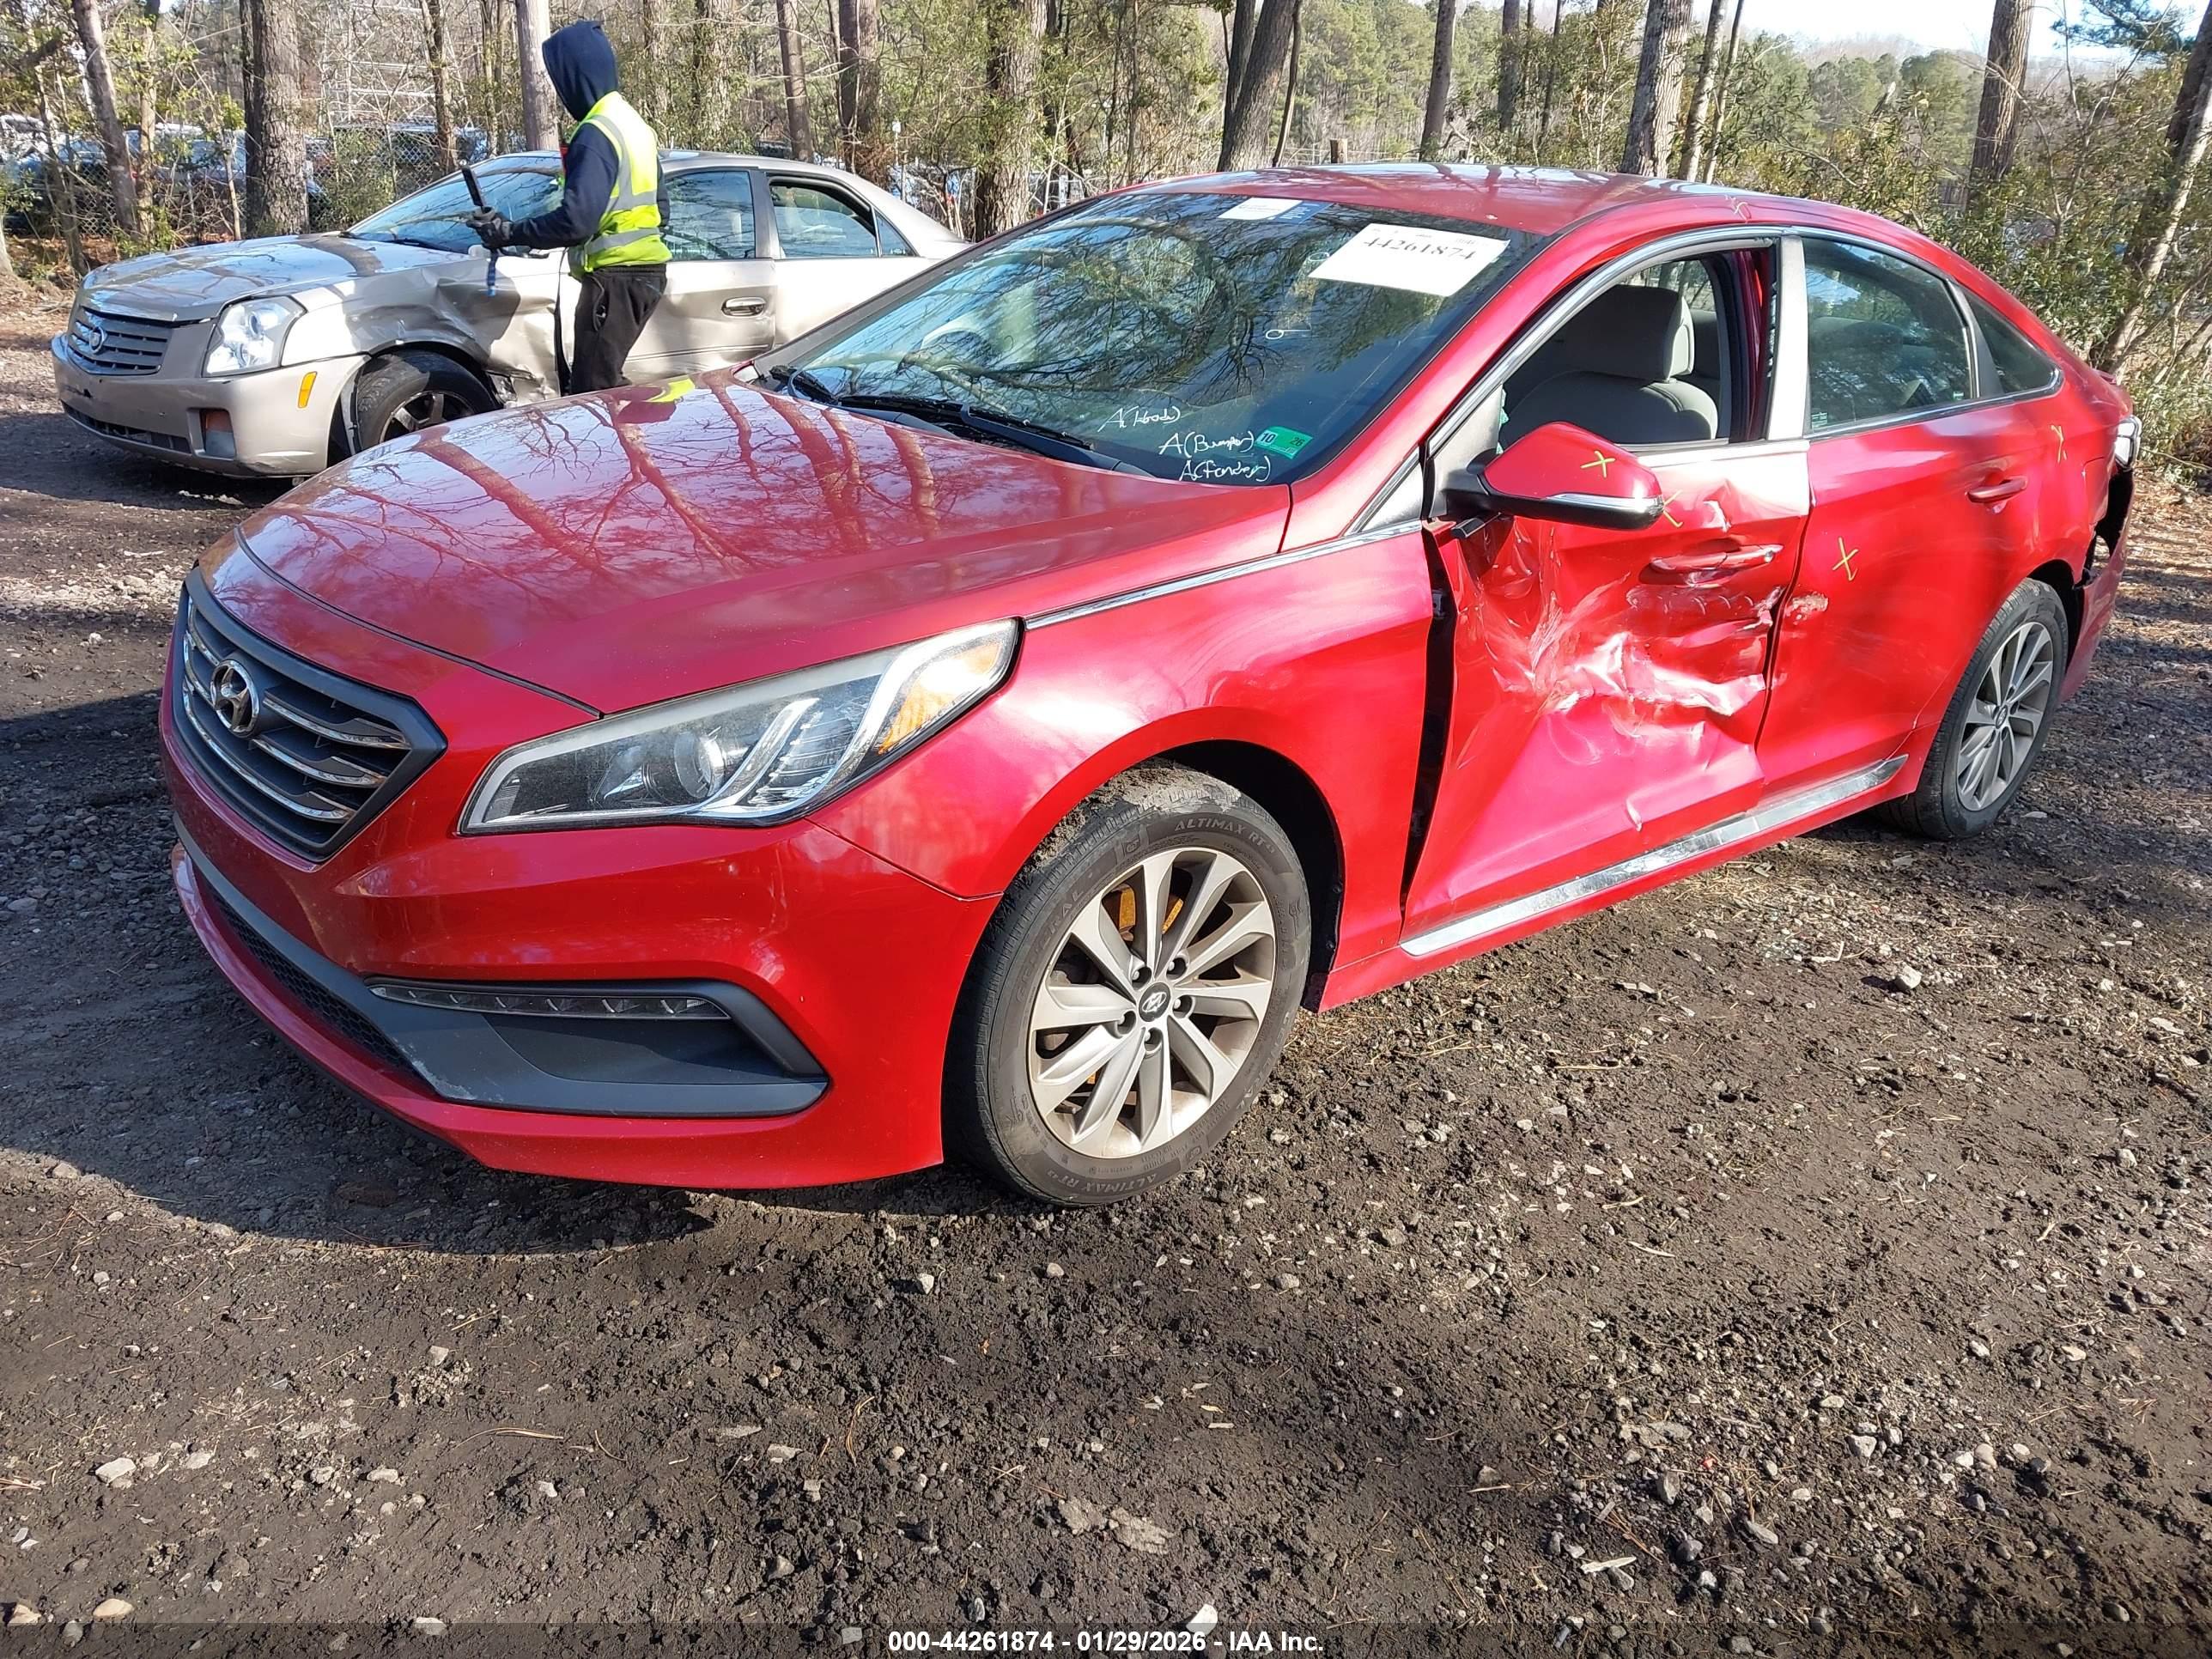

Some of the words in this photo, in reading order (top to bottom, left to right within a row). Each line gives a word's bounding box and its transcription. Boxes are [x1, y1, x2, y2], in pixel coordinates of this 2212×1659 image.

[1364, 236, 1477, 260] 44261874
[1260, 432, 1276, 444] 10
[1290, 436, 1306, 447] 26
[1175, 817, 1246, 835] ALTIMAX
